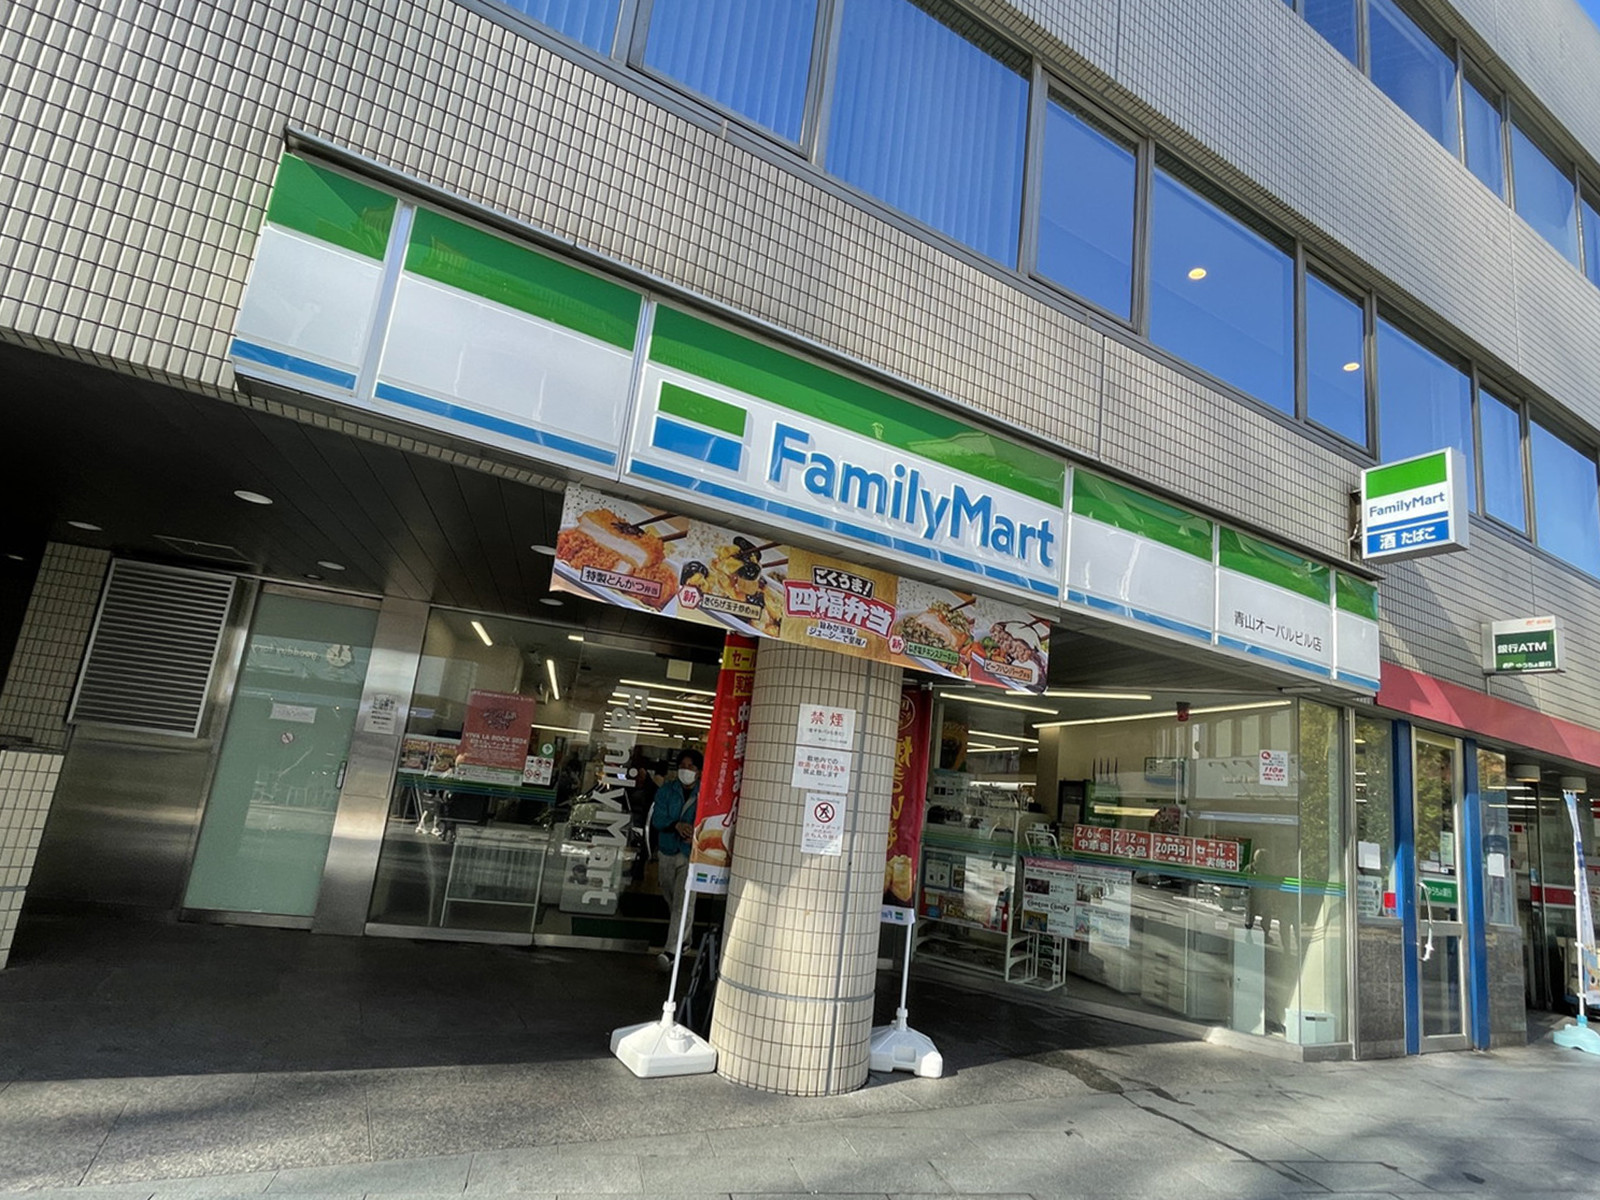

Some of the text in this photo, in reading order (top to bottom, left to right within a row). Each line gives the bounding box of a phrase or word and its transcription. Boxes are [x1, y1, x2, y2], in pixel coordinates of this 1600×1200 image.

[767, 421, 1055, 568] FamilyMart
[1369, 491, 1446, 518] FamilyMart
[1379, 526, 1437, 550] 酒 たばこ
[786, 585, 893, 636] 四福弁当
[1233, 610, 1323, 653] 青山オーバルビル店
[1497, 641, 1548, 655] 銀行ATM
[810, 710, 844, 728] 禁煙
